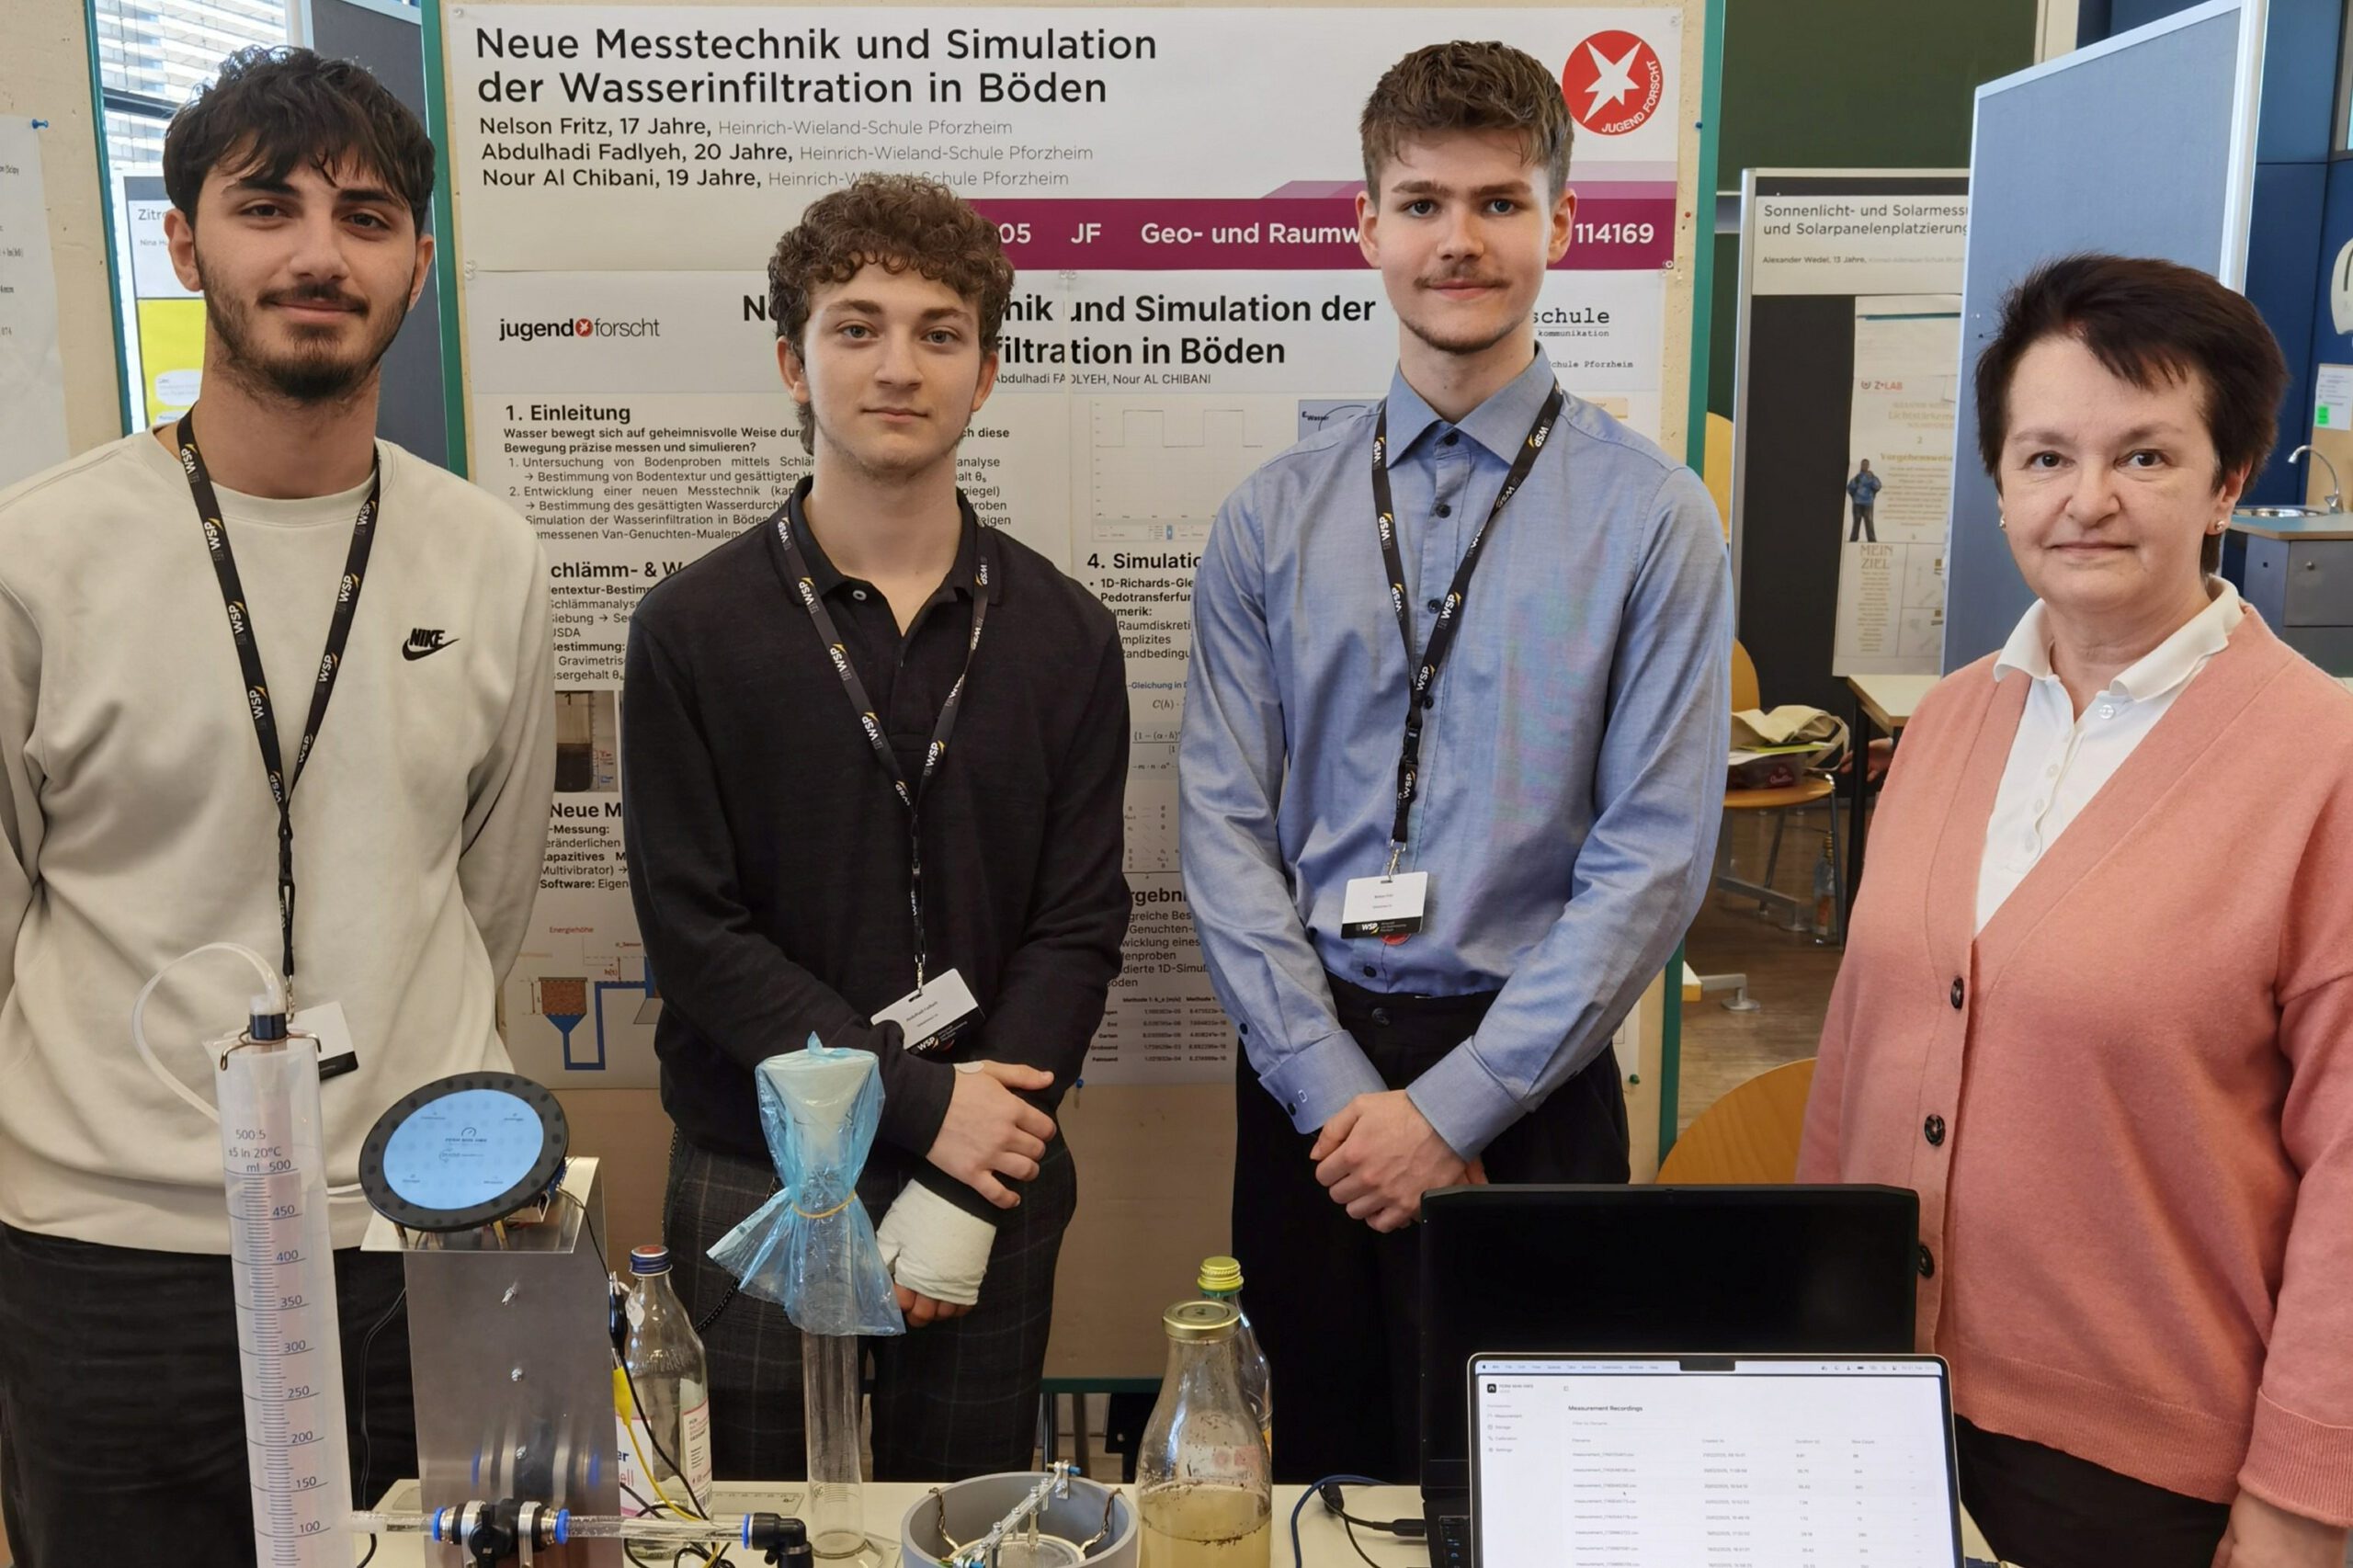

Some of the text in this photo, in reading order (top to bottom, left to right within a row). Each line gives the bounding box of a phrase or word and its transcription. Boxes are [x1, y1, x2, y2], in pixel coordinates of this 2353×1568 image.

[477, 28, 1155, 59] Neue Messtechnik und Simulation
[479, 71, 1105, 103] der Wasserinfiltration in Böden
[1601, 60, 1659, 133] JUGEND FORSCHT
[481, 118, 1012, 137] Nelson Fritz, 17 Jahre, Heinrich-Wieland-Schule Pforzheim
[482, 143, 1093, 163] Abdulhadi Fadlyeh, 20 Jahre, Heinrich-Wieland-Schule Pforzheim
[483, 169, 1068, 188] Nour Al Chibani, 19 Jahre, Pforzheim
[1765, 205, 1855, 217] Sonnenlicht-
[1860, 205, 1887, 216] und
[1071, 223, 1101, 243] JF
[1142, 223, 1202, 243] Geo-
[1212, 222, 1258, 244] und
[1575, 223, 1654, 244] 114169
[1764, 223, 1790, 234] und
[1136, 294, 1310, 322] Simulation
[1322, 295, 1376, 321] der
[1143, 336, 1170, 364] in
[1182, 336, 1284, 364] Böden
[1113, 375, 1140, 384] Nour
[1144, 374, 1158, 384] AL
[1163, 374, 1211, 384] CHIBANI
[506, 404, 630, 425] 1. Einleitung
[504, 427, 777, 440] Wasser bewegt sich auf geheimnisvolle Weise
[978, 427, 1009, 437] diese
[1535, 426, 1549, 447] WSP
[505, 443, 566, 455] Bewegung
[570, 443, 612, 454] präzise
[664, 443, 686, 451] und
[689, 442, 756, 451] simulieren?
[1373, 441, 1381, 461] WSP
[181, 448, 198, 476] WSP
[509, 457, 769, 469] 1. Untersuchung von Bodenproben mittels
[539, 472, 800, 484] Bestimmung von Bodentextur und gesättigten
[509, 486, 519, 496] 2.
[524, 486, 593, 498] Entwicklung
[604, 486, 632, 495] einer
[688, 486, 760, 495] Messtechnik
[358, 502, 370, 527] WSP
[540, 501, 610, 513] Bestimmung
[614, 501, 634, 510] des
[638, 500, 702, 512] gesättigten
[590, 516, 608, 525] der
[614, 514, 712, 525] Wasserinfiltration
[718, 515, 728, 524] in
[1380, 516, 1391, 540] WSP
[205, 521, 221, 551] WSP
[644, 562, 656, 577] &
[1087, 553, 1105, 568] 4.
[980, 564, 988, 585] WSP
[340, 574, 354, 604] WSP
[799, 581, 814, 608] WSP
[1392, 586, 1403, 614] WSP
[1441, 594, 1455, 619] WSP
[228, 604, 244, 634] WSP
[409, 628, 445, 650] NIKE
[318, 654, 334, 684] WSP
[559, 656, 625, 665] Gravimetris
[829, 647, 847, 675] WSP
[1416, 666, 1429, 692] WSP
[249, 689, 265, 722] WSP
[862, 715, 879, 742] WSP
[926, 743, 938, 767] WSP
[1404, 773, 1413, 798] WSP
[551, 803, 598, 818] Neue
[540, 879, 596, 889] Software:
[1362, 923, 1378, 931] WSP
[917, 1037, 935, 1051] WSP
[246, 1160, 290, 1173] ml 500
[272, 1205, 294, 1217] 450
[276, 1250, 298, 1261] 400
[280, 1295, 302, 1307] 350
[284, 1339, 306, 1352] 300
[288, 1385, 310, 1398] 250
[291, 1431, 313, 1443] 200
[297, 1476, 316, 1488] 150
[301, 1521, 320, 1533] 100
